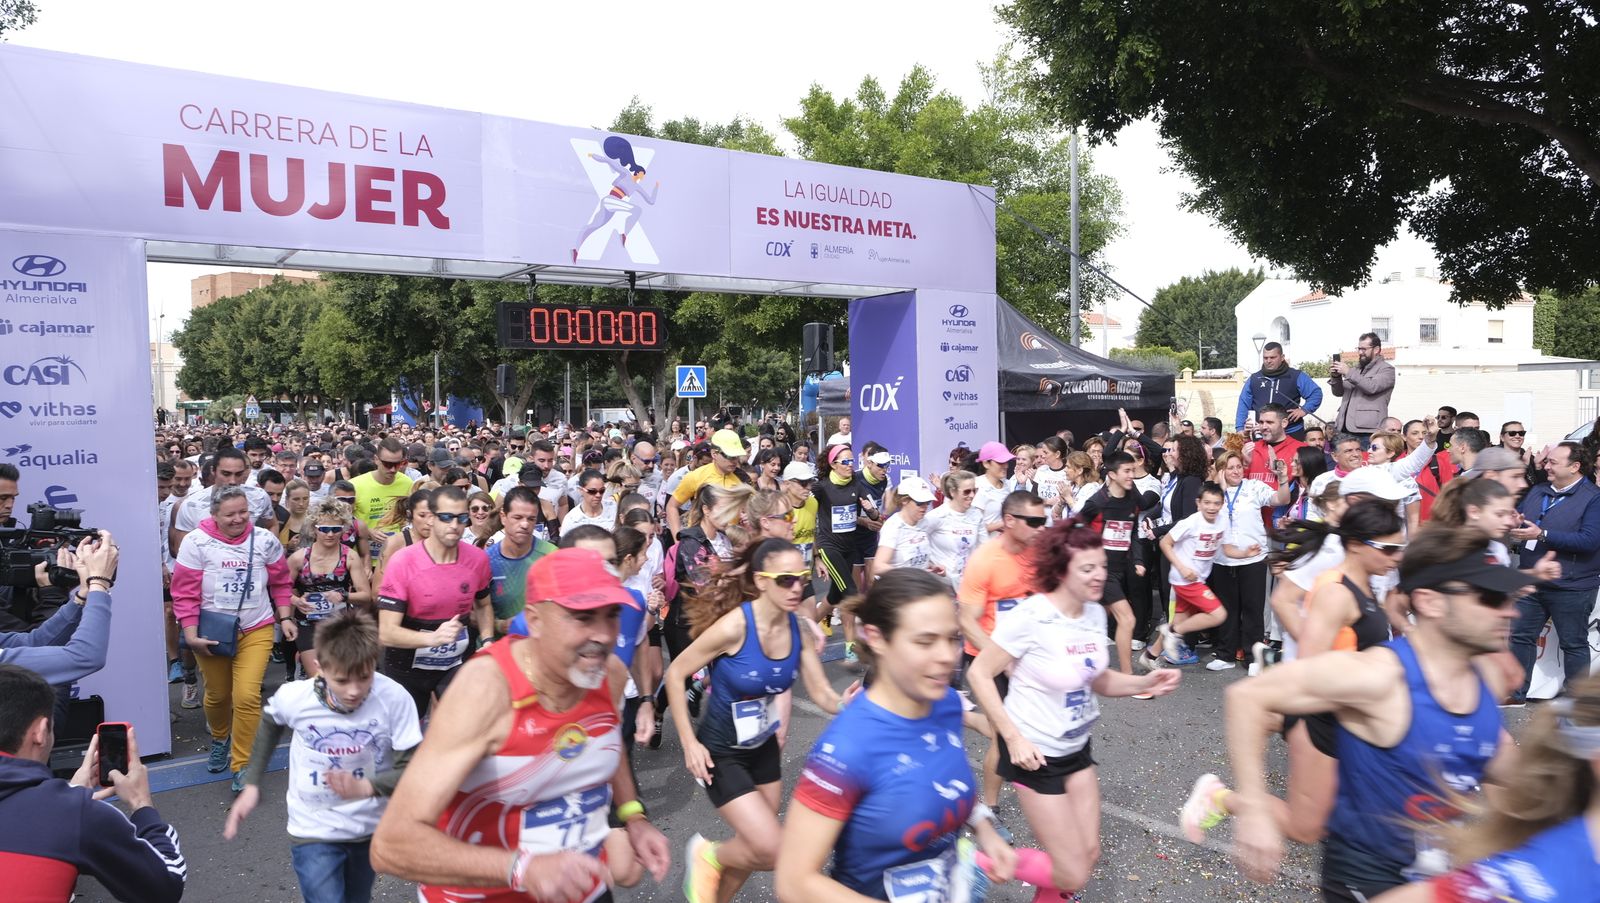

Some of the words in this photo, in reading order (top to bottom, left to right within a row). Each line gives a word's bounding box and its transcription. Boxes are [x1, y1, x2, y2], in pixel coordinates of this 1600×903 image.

[180, 104, 338, 148] CARRERA
[350, 125, 388, 153] DE
[399, 132, 434, 158] LA
[162, 143, 450, 230] MUJER
[784, 179, 805, 199] LA
[810, 183, 893, 209] IGUALDAD
[756, 207, 780, 226] ES
[784, 210, 865, 236] NUESTRA
[867, 219, 917, 240] META.
[766, 240, 794, 257] CDX
[824, 244, 854, 255] ALMERÍA
[6, 293, 77, 305] Almerialva
[19, 321, 95, 336] cajamar
[530, 308, 657, 345] 00:00:00
[942, 319, 976, 327] HYUNDAI
[951, 343, 978, 353] cajamar
[3, 364, 70, 386] CASI
[860, 376, 904, 412] CDX
[953, 391, 978, 401] vithas
[29, 402, 97, 417] vithas
[66, 419, 98, 427] cuidarte
[949, 420, 978, 432] aqualia
[19, 450, 98, 471] aqualia
[890, 453, 911, 465] ERÍA
[839, 513, 854, 521] 293
[430, 642, 457, 654] 454
